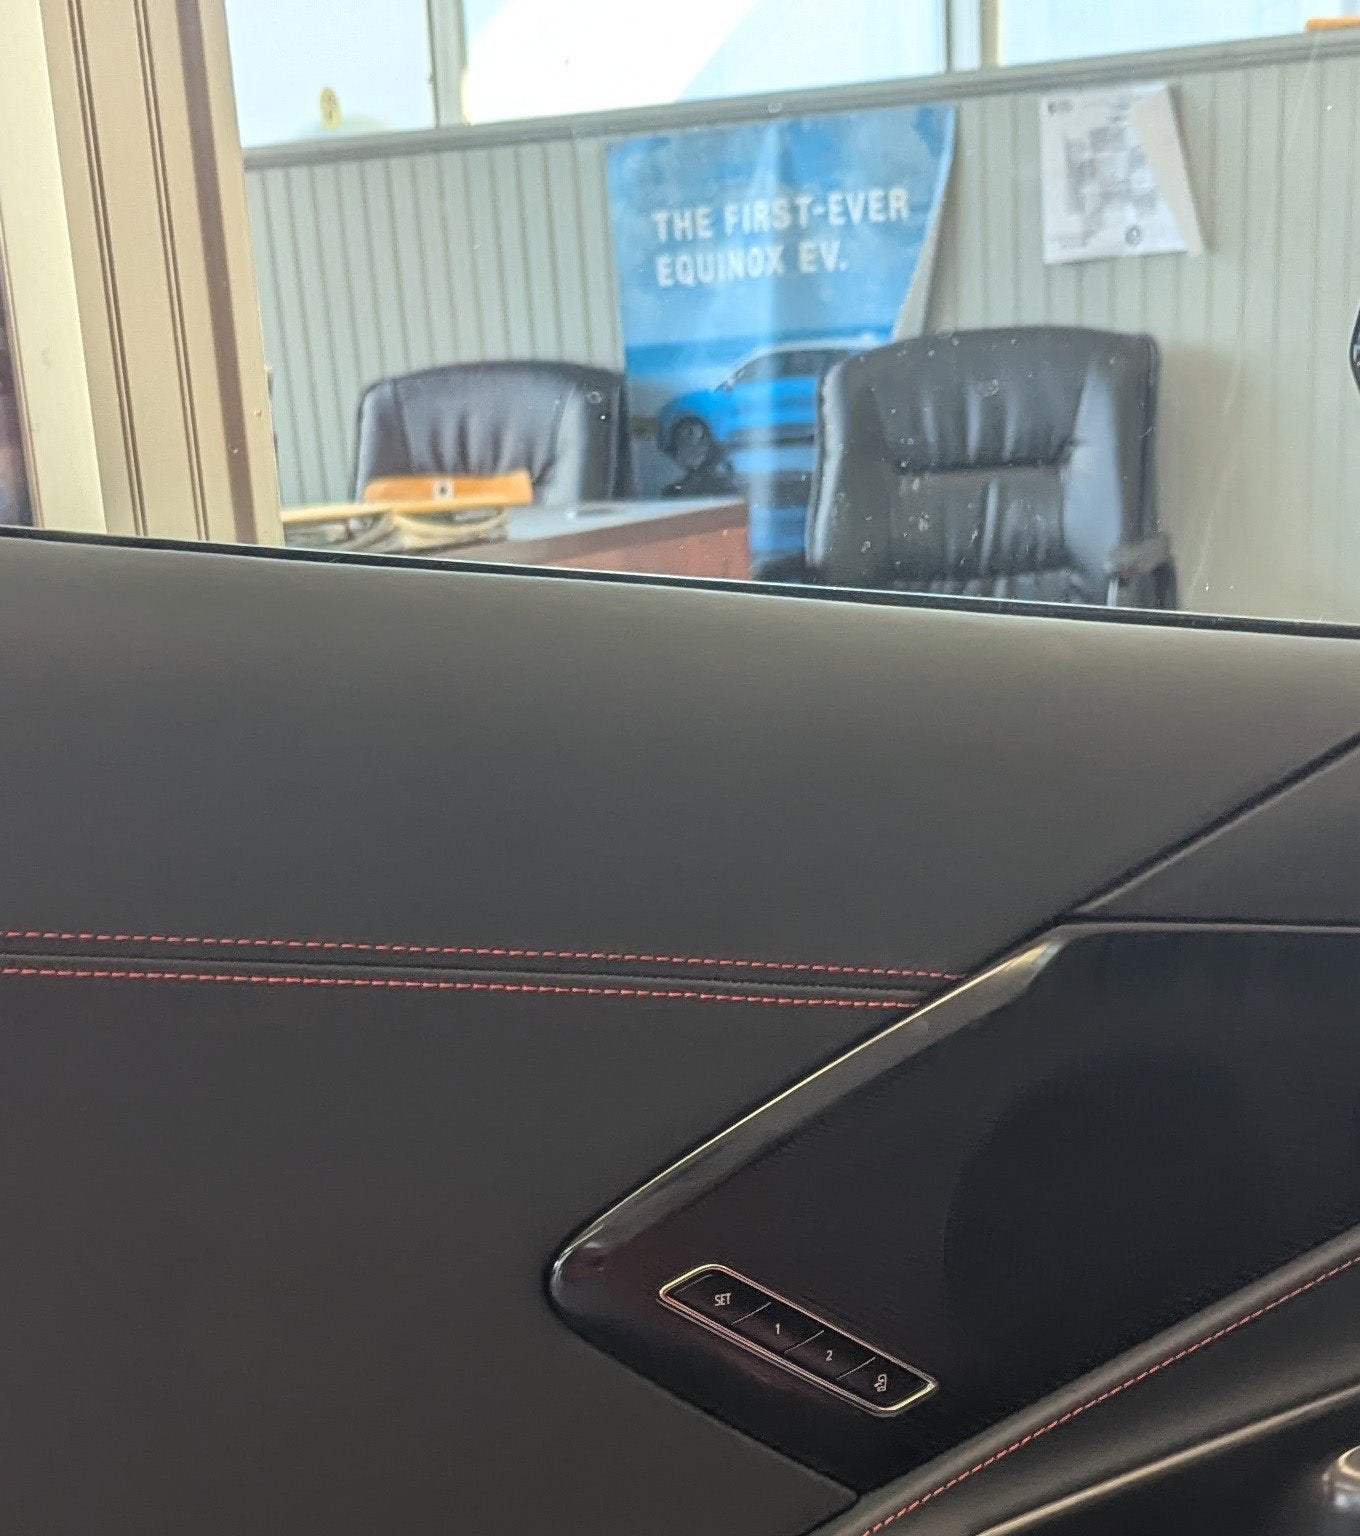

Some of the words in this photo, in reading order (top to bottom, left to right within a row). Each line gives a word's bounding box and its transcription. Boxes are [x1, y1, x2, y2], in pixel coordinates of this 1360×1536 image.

[652, 206, 714, 244] THE
[723, 187, 911, 237] FIRST-EVER
[655, 244, 787, 288] EQUINOX
[797, 240, 849, 274] EV.
[714, 1292, 732, 1307] SET
[774, 1323, 781, 1335] 1
[826, 1350, 833, 1362] 2
